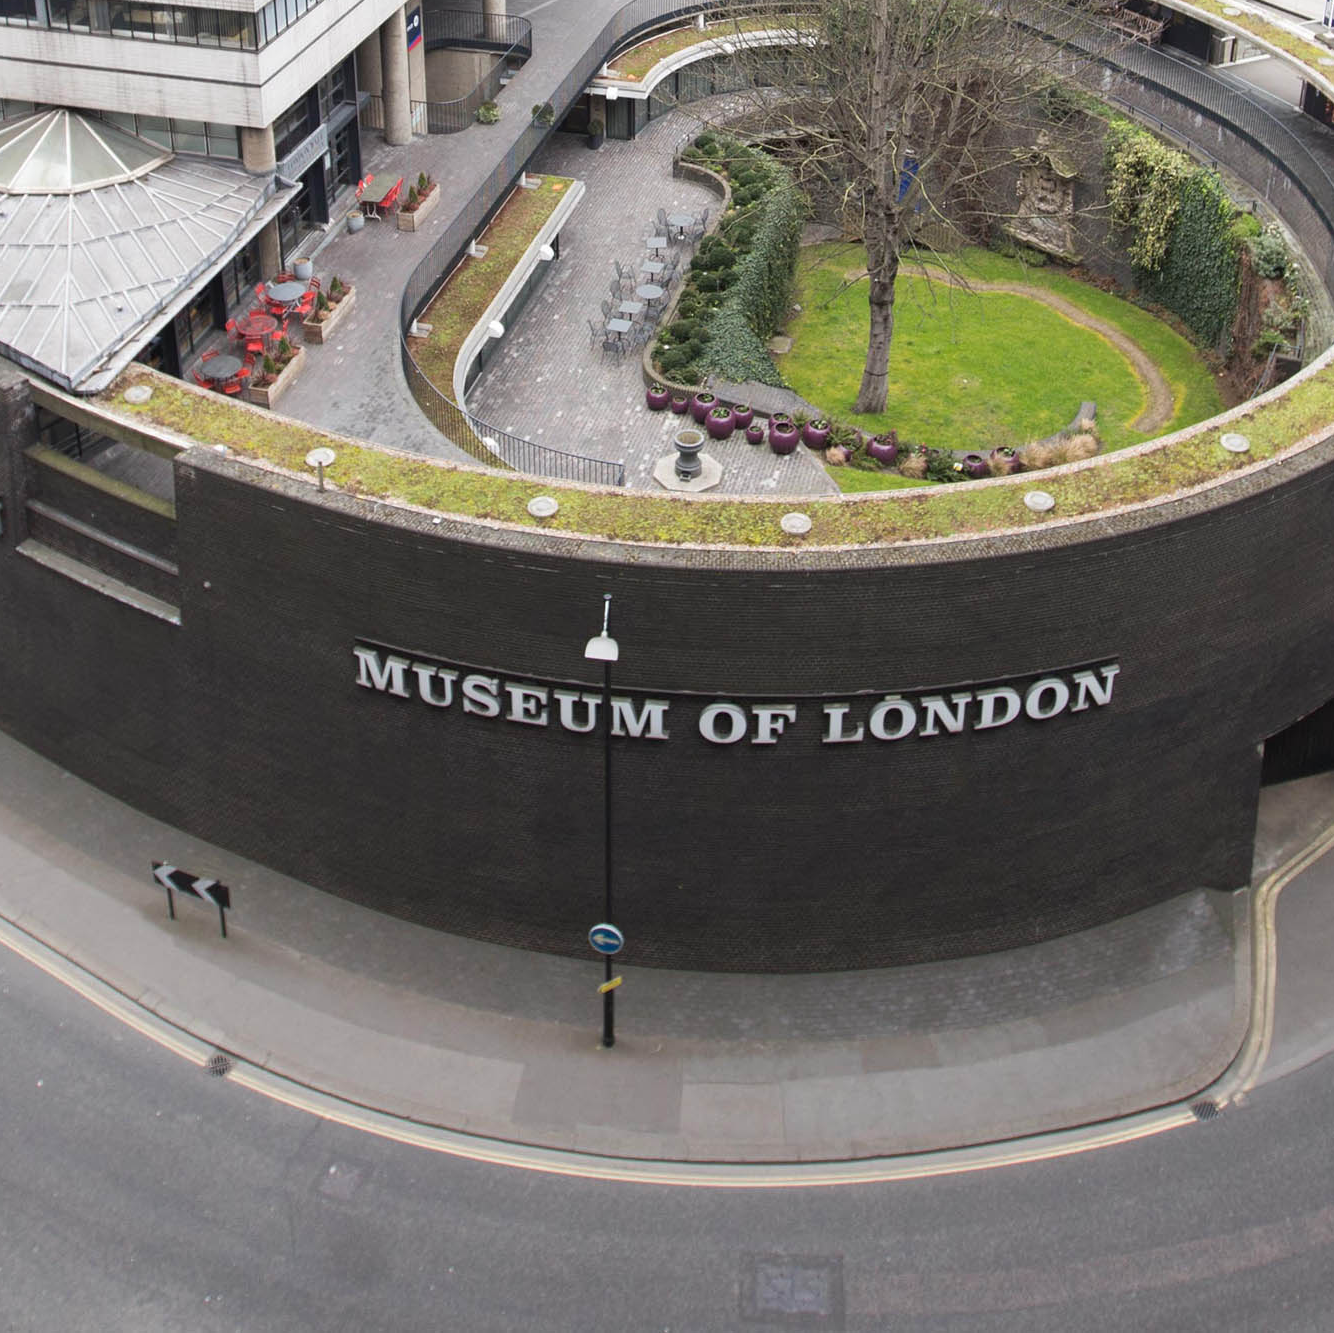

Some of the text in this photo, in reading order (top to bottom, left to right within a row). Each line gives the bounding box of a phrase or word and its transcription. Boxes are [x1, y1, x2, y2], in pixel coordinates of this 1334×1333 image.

[353, 646, 1120, 744] MUSEUM OF LONDON
